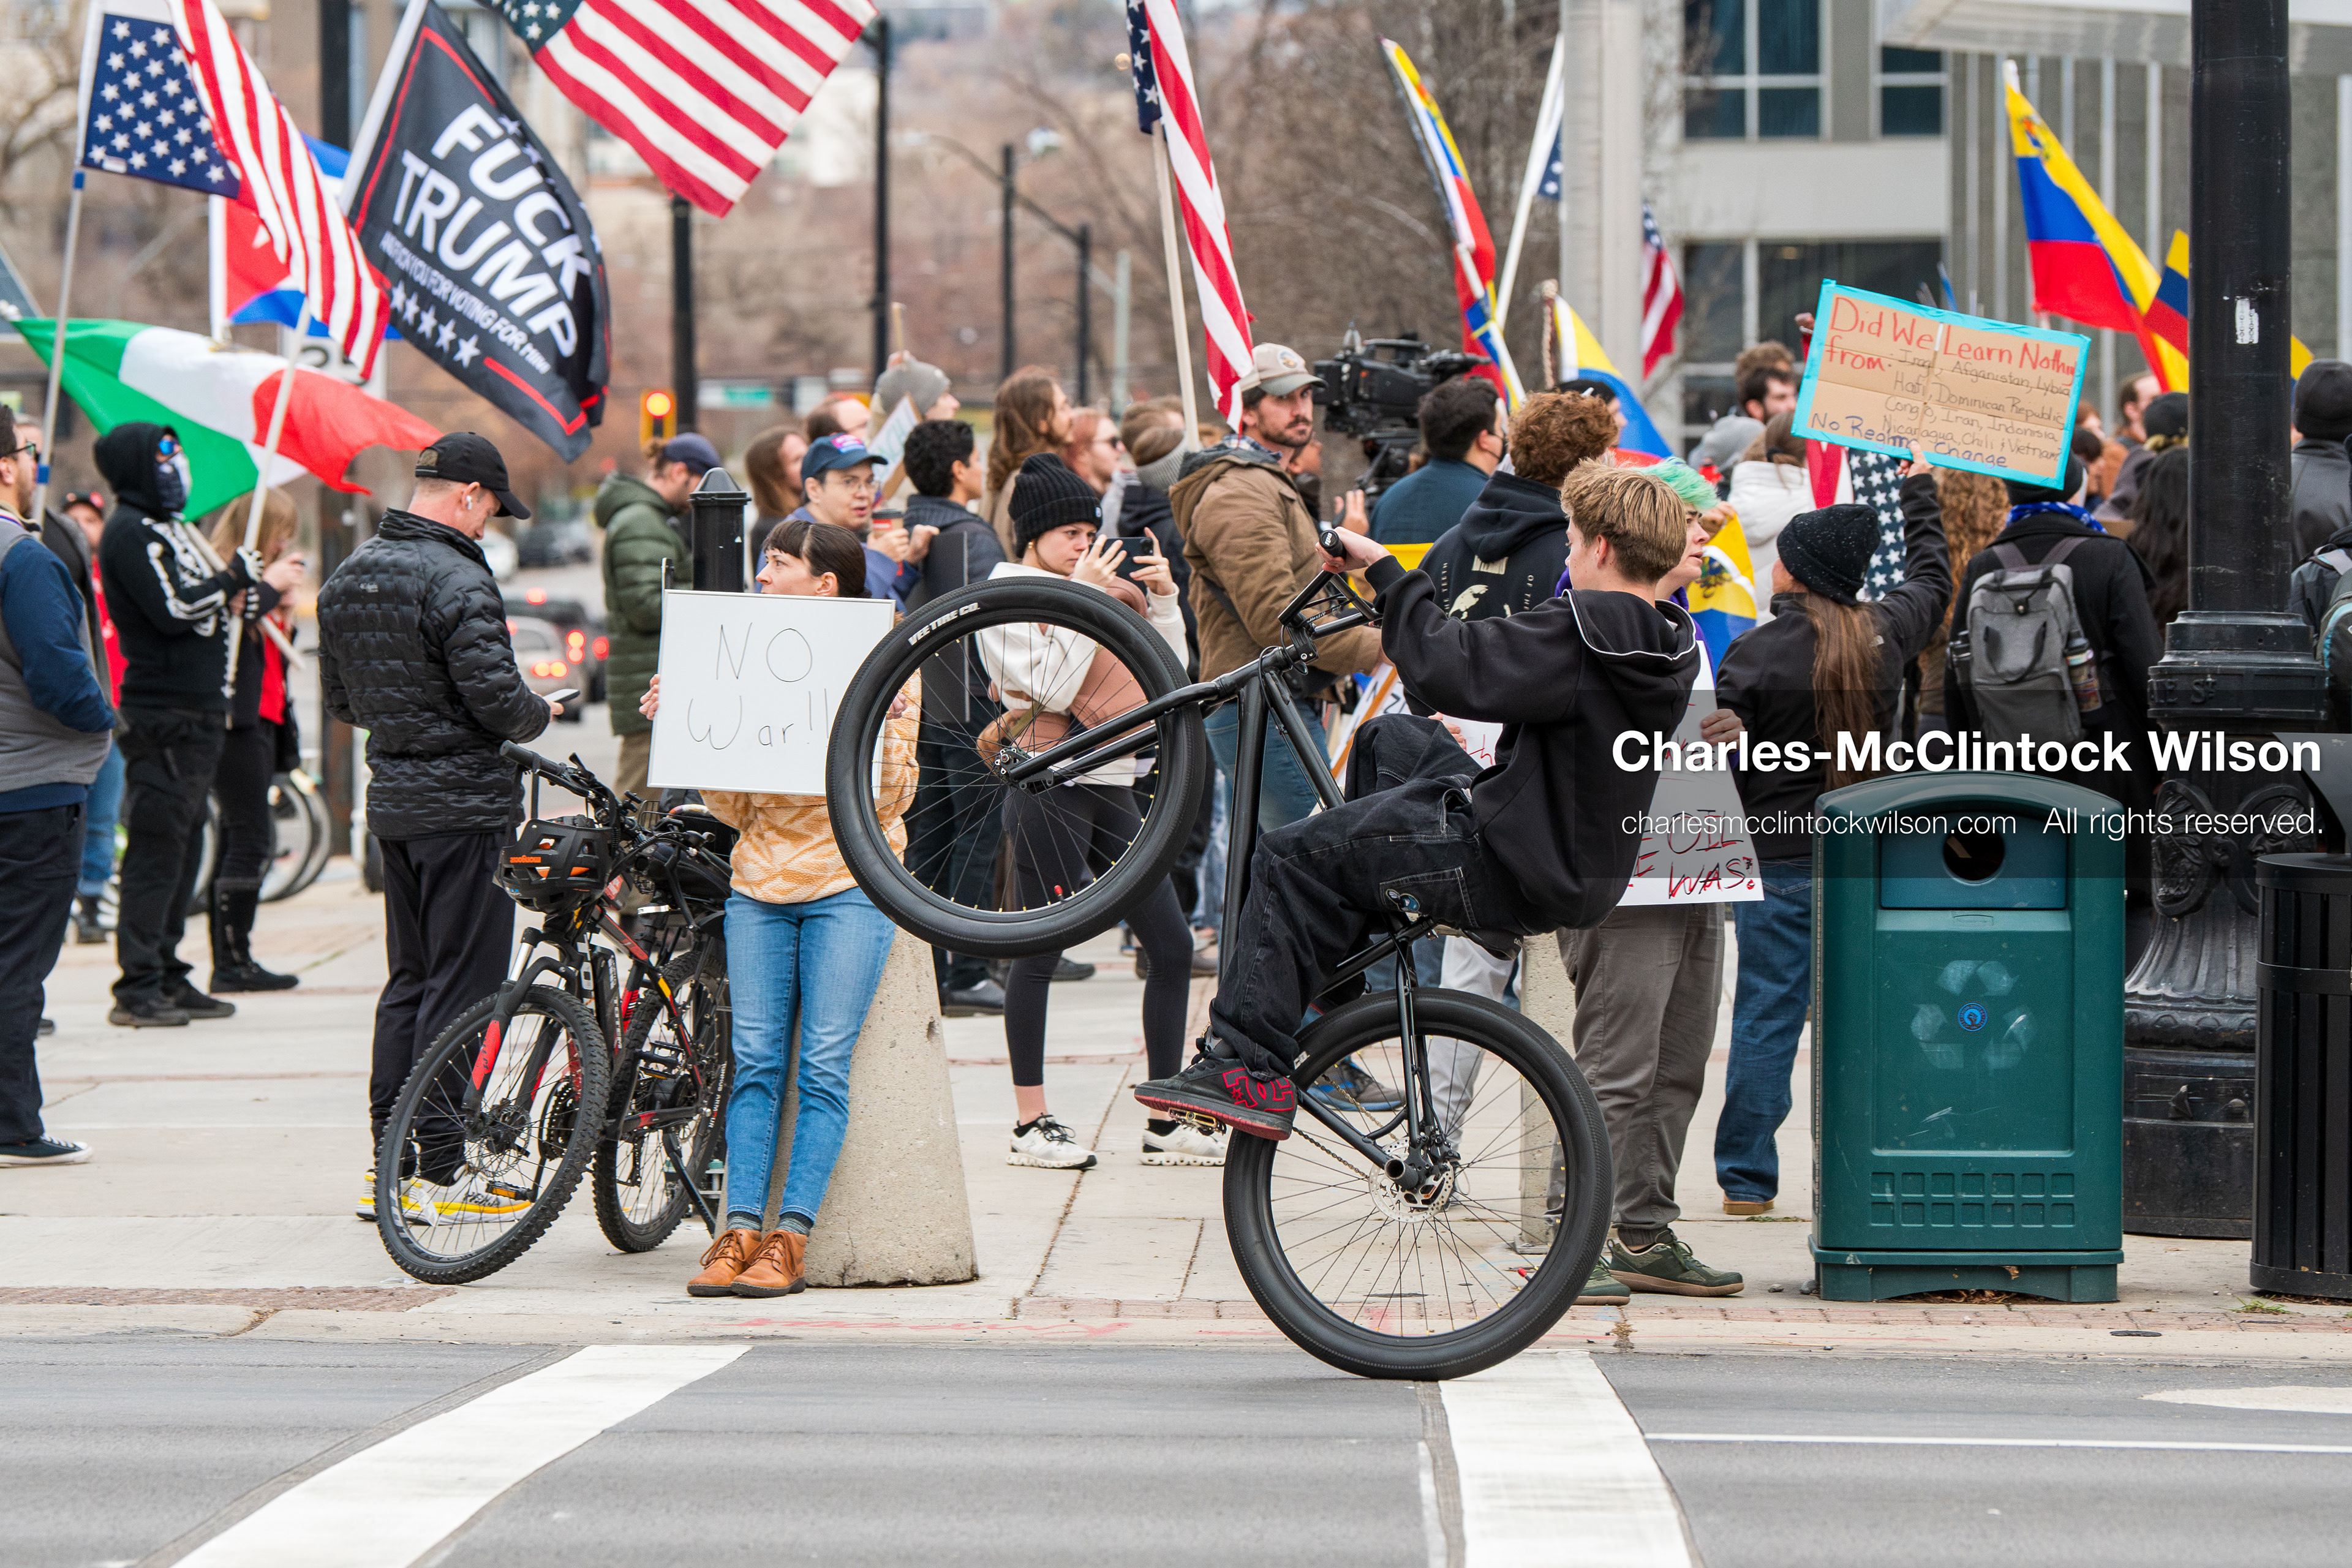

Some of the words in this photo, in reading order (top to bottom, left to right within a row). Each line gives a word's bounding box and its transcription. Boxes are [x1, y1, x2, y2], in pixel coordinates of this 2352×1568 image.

[431, 102, 592, 301] FUCK
[392, 149, 578, 358] TRUMP
[448, 288, 498, 330] VOTING
[489, 317, 528, 351] FOR
[1830, 296, 1883, 337] Did
[1893, 312, 1934, 350] We
[1943, 325, 2013, 364] Learn
[1811, 412, 1840, 431] No
[1934, 442, 2008, 469] Change
[715, 622, 813, 683] NO
[908, 625, 931, 646] VEE
[929, 609, 959, 631] TIRE
